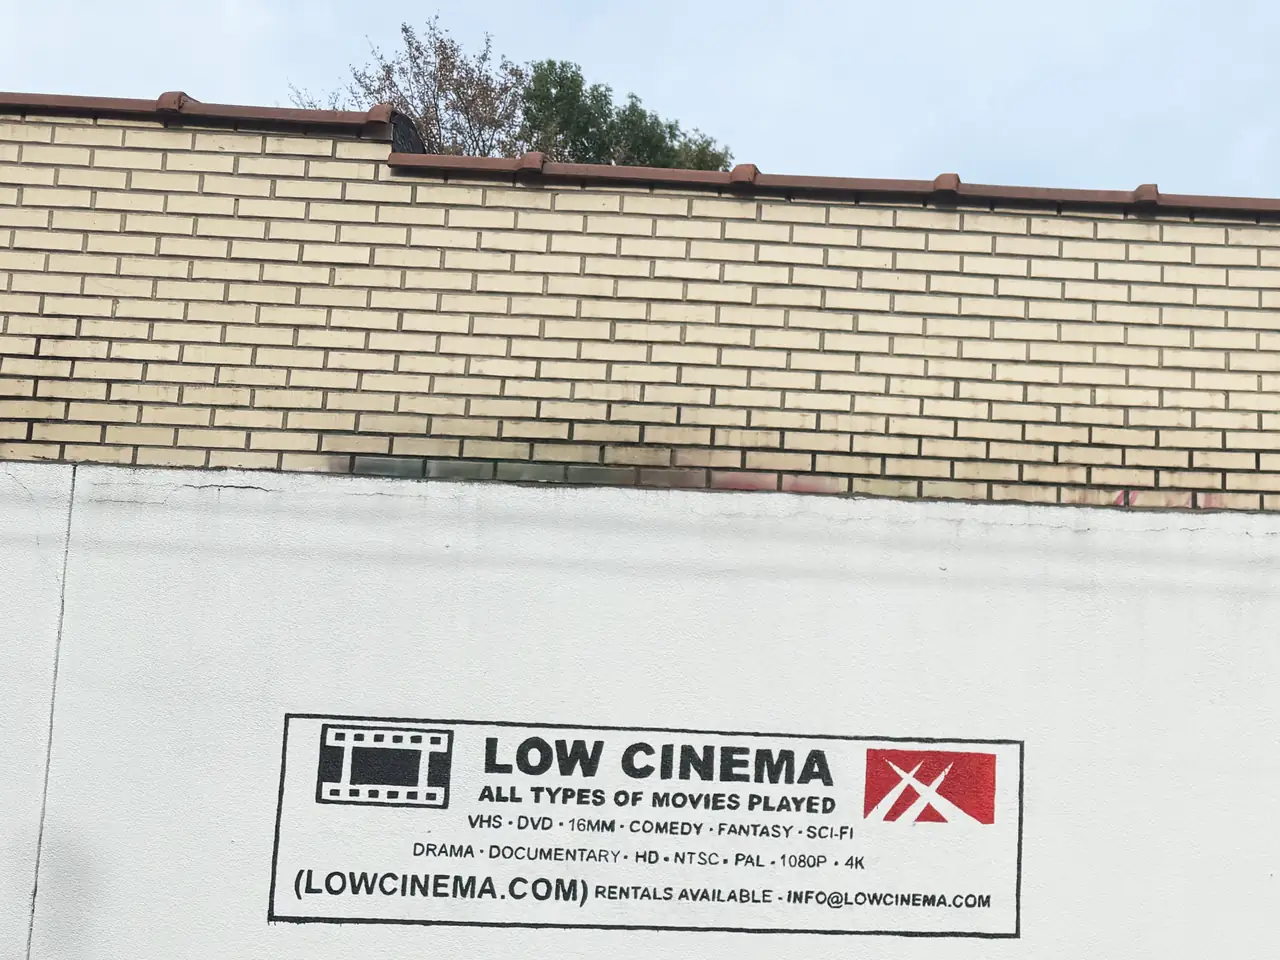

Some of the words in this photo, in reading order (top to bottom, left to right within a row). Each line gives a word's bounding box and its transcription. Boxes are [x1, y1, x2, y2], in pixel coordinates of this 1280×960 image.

[485, 737, 604, 777] LOW
[622, 742, 833, 786] CINEMA
[478, 786, 522, 803] ALL
[530, 787, 605, 806] TYPES
[614, 790, 643, 806] OF
[652, 792, 740, 810] MOVIES
[748, 794, 835, 814] PLAYED
[468, 815, 502, 829] VHS
[518, 816, 552, 830] DVD
[569, 819, 615, 832] 16MM
[630, 820, 703, 835] COMEDY
[718, 823, 793, 838] FANTASY
[807, 826, 853, 840] SCI-FI
[413, 843, 474, 858] DRAMA
[489, 845, 620, 863] DOCUMENTARY
[636, 851, 659, 864] HD
[674, 852, 719, 865] NTSC
[735, 853, 764, 867] PAL
[781, 854, 827, 868] 1080P
[845, 856, 864, 869] 4K
[295, 870, 588, 907] (LOWCINEMA.COM)
[595, 886, 673, 900] RENTALS
[678, 889, 773, 903] AVAILABLE
[787, 890, 990, 908] INFO@LOWCINEMA.COM
